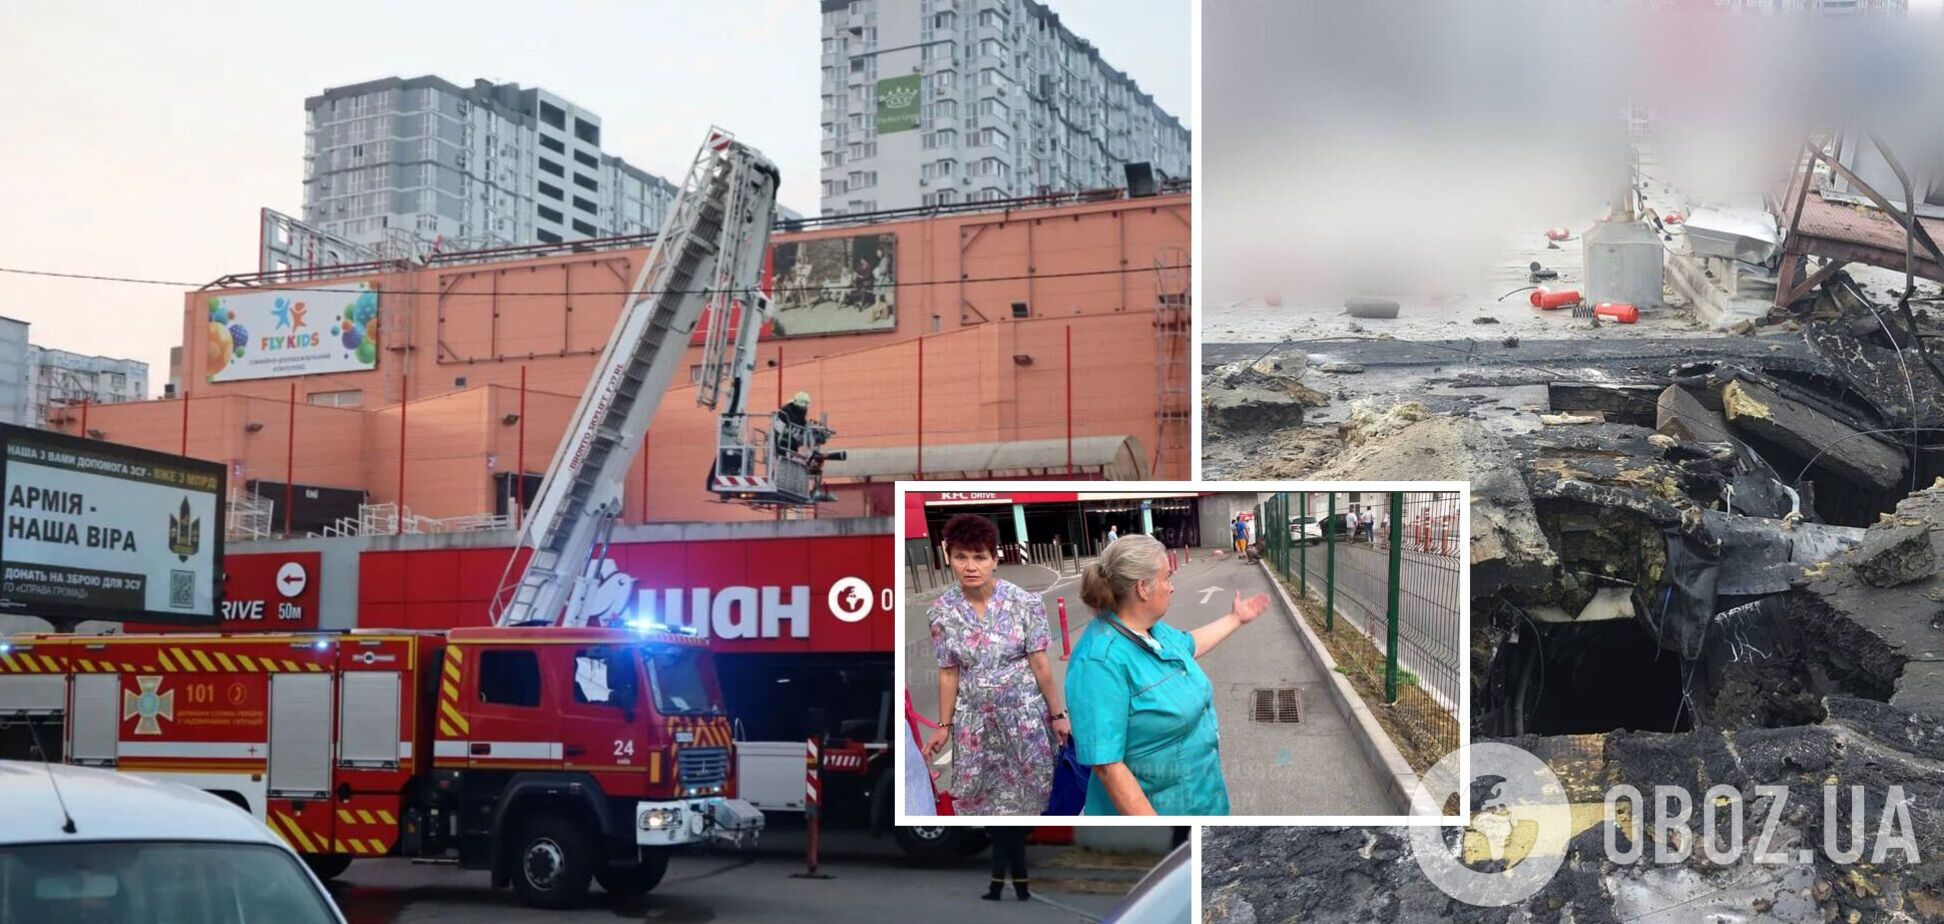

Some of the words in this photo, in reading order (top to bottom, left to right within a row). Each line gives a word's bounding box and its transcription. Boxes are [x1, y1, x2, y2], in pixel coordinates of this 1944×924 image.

[261, 335, 285, 351] FLY
[287, 332, 319, 349] KIDS
[7, 444, 38, 458] НАША
[47, 451, 76, 465] ВАМИ
[77, 455, 129, 475] ДОПОМОГА
[129, 465, 147, 477] ЗСУ
[9, 485, 83, 516] АРМІЯ
[8, 515, 79, 546] НАША
[86, 525, 137, 553] ВІРА
[4, 567, 47, 581] ДОНАТЬ
[49, 572, 64, 583] НА
[66, 573, 101, 587] ЗБРОЮ
[101, 577, 122, 590] ДЛЯ
[124, 579, 142, 591] ЗСУ
[186, 683, 215, 704] 101
[613, 739, 635, 756] 24
